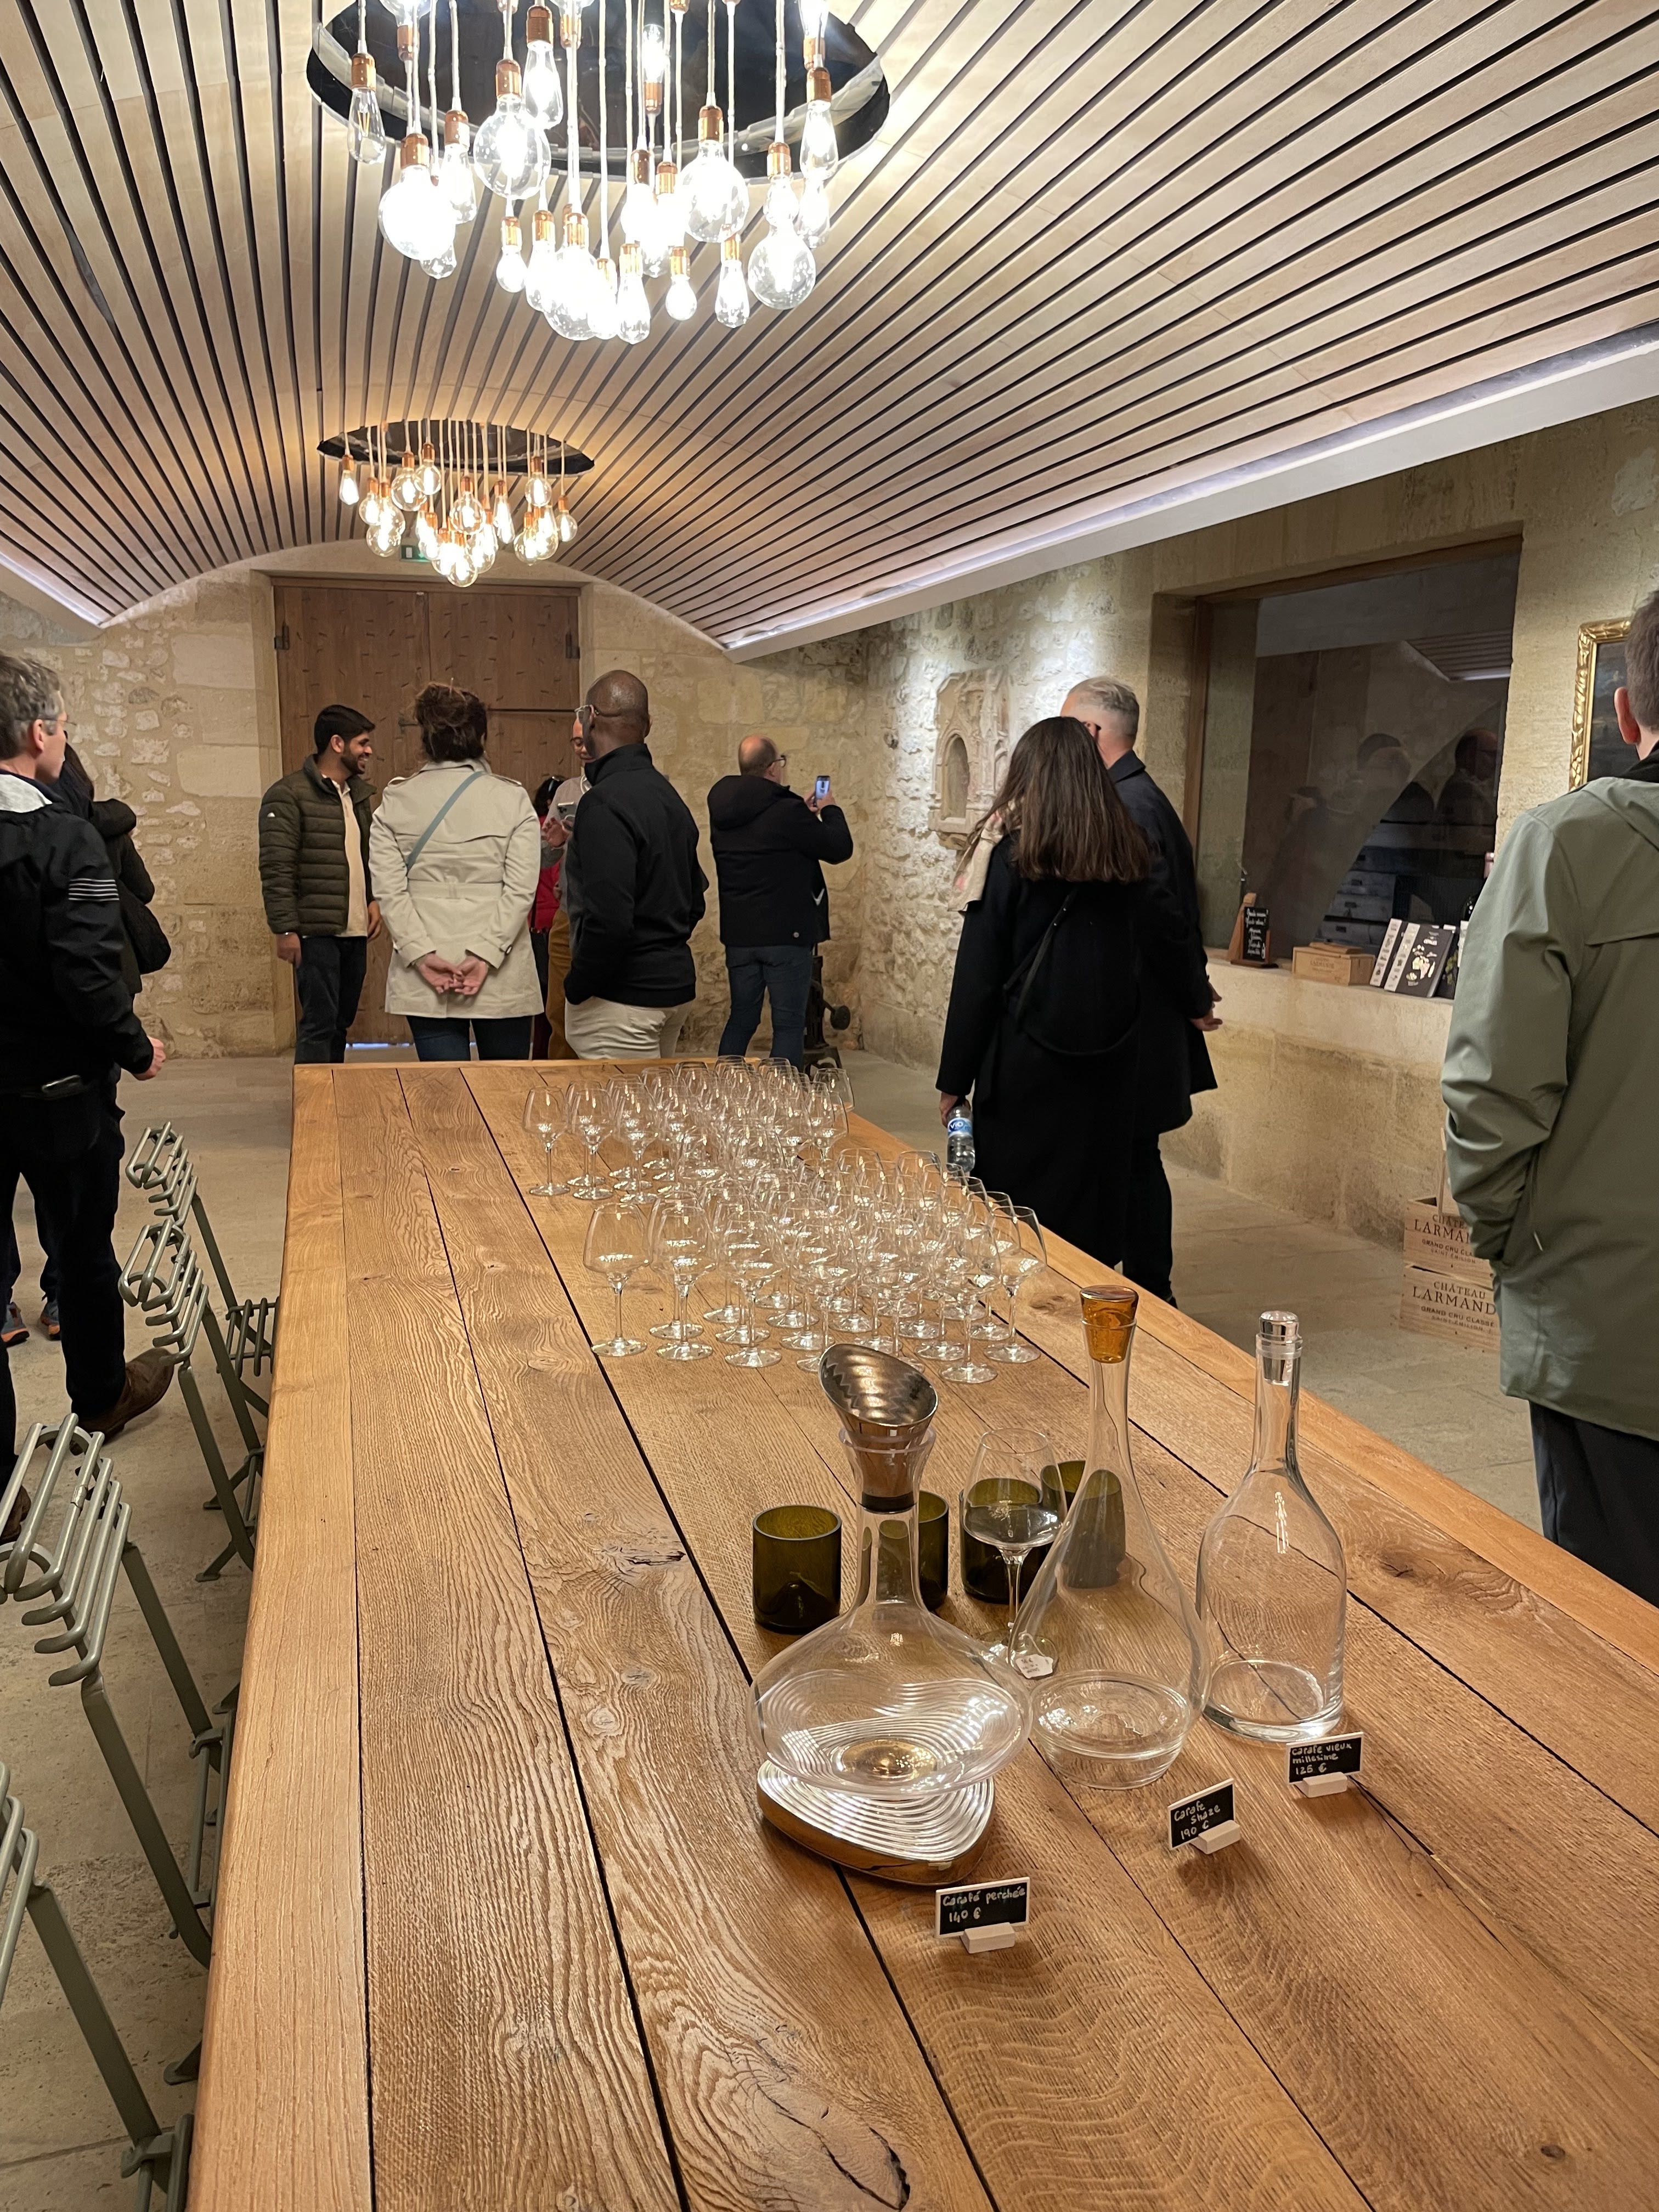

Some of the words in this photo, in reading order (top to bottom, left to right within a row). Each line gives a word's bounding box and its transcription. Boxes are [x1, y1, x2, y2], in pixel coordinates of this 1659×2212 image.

[1414, 1219, 1469, 1244] LARMA
[1422, 1239, 1443, 1249] GRAND
[1445, 1245, 1458, 1254] CRU
[1421, 1306, 1446, 1316] GRAND
[1318, 1763, 1327, 1773] €
[1181, 1827, 1197, 1840] 190
[949, 1910, 968, 1923] 140
[973, 1907, 981, 1919] €
